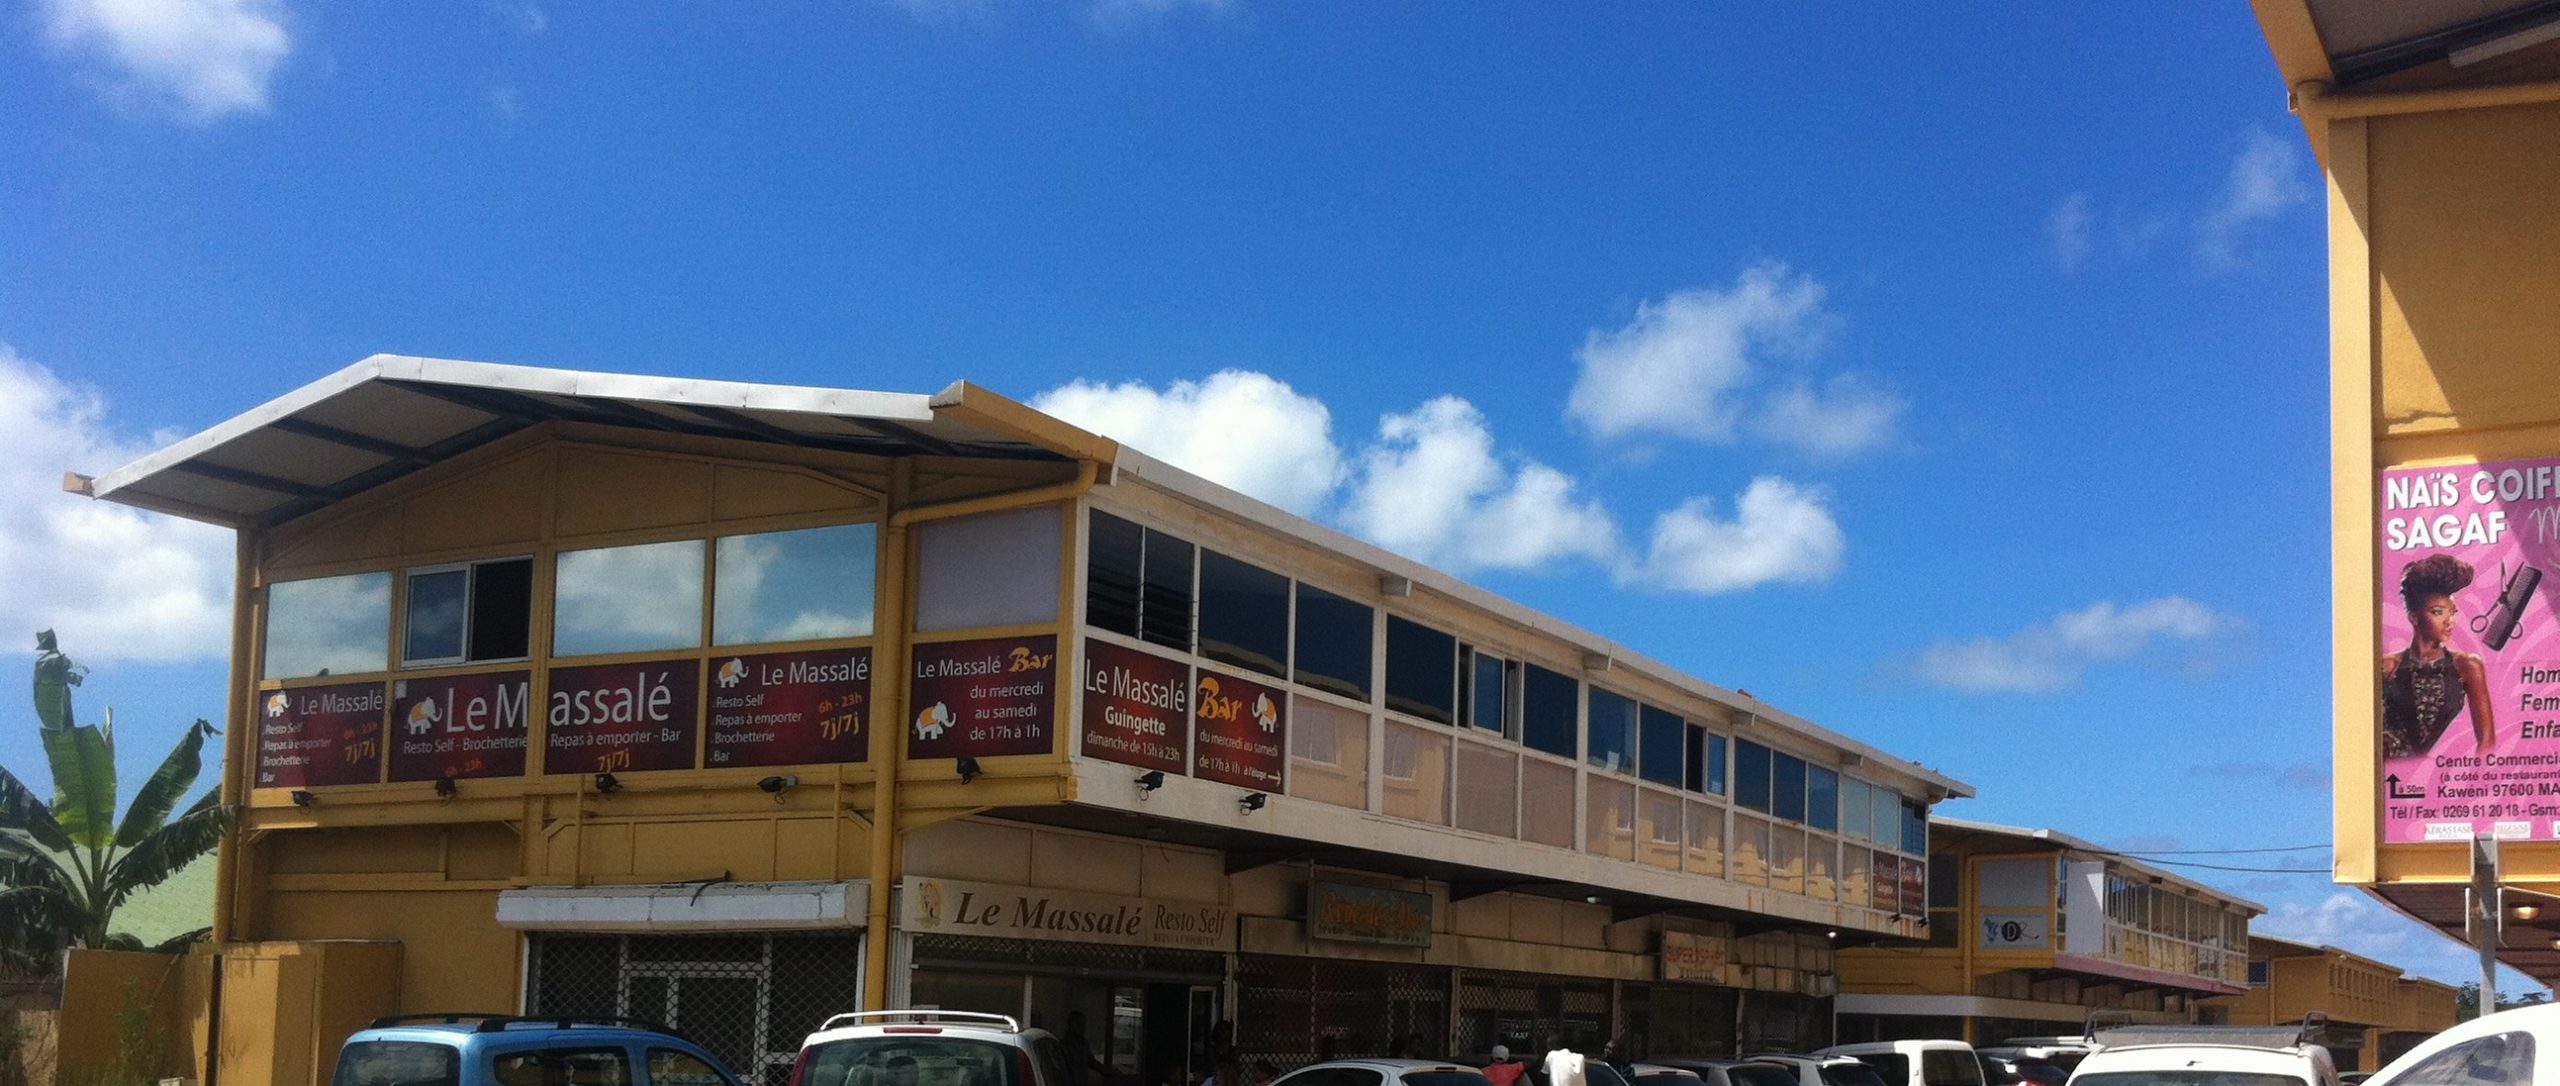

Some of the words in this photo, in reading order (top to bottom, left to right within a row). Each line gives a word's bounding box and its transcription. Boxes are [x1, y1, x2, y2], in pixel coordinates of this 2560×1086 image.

[2387, 511, 2507, 551] SAGAF
[762, 664, 784, 686] Le
[789, 656, 868, 684] Massalé
[918, 661, 935, 678] Le
[939, 656, 1001, 676] Massalé
[1008, 646, 1053, 673] Bar
[970, 685, 986, 699] du
[989, 681, 1044, 698] mercredi
[1086, 659, 1108, 694] Le
[1113, 666, 1185, 712] Massalé
[301, 696, 318, 715] Le
[321, 689, 383, 713] Massalé
[717, 697, 743, 708] Resto
[746, 694, 765, 706] Self
[1197, 676, 1243, 722] Bar
[447, 687, 488, 733] Le
[975, 709, 990, 719] au
[993, 702, 1037, 718] samedi
[715, 714, 744, 728] Repas
[746, 713, 752, 725] à
[755, 712, 802, 727] emporter
[820, 712, 860, 741] 7j/7j
[1105, 706, 1166, 736] Guingette
[551, 733, 584, 749] Repas
[586, 732, 593, 745] à
[597, 731, 652, 747] emporter
[662, 728, 681, 742] Bar
[715, 731, 775, 744] Brochetterie
[970, 726, 986, 740] de
[990, 725, 1011, 739] 17h
[1014, 726, 1021, 739] à
[1026, 723, 1040, 738] 1h
[1200, 729, 1210, 743] du
[1211, 734, 1243, 750] mercredi
[404, 741, 433, 754] Resto
[435, 738, 455, 753] Self
[1087, 730, 1129, 751] dimanche
[1130, 739, 1140, 753] de
[714, 751, 731, 762] Bar
[1199, 754, 1209, 768] de
[2436, 755, 2481, 768] Centre
[2486, 751, 2560, 766] Commerci
[2454, 771, 2479, 781] côté
[2482, 772, 2497, 780] du
[2407, 785, 2425, 794] 50m
[2438, 785, 2488, 798] Kawéni
[2493, 783, 2533, 796] 97600
[2443, 805, 2469, 818] 0269
[2472, 805, 2485, 817] 61
[2488, 804, 2502, 817] 20
[2506, 804, 2519, 816] 18
[952, 892, 1001, 926] Le
[1010, 896, 1142, 936] Massalé
[1155, 904, 1194, 931] Resto
[1198, 908, 1228, 940] Self
